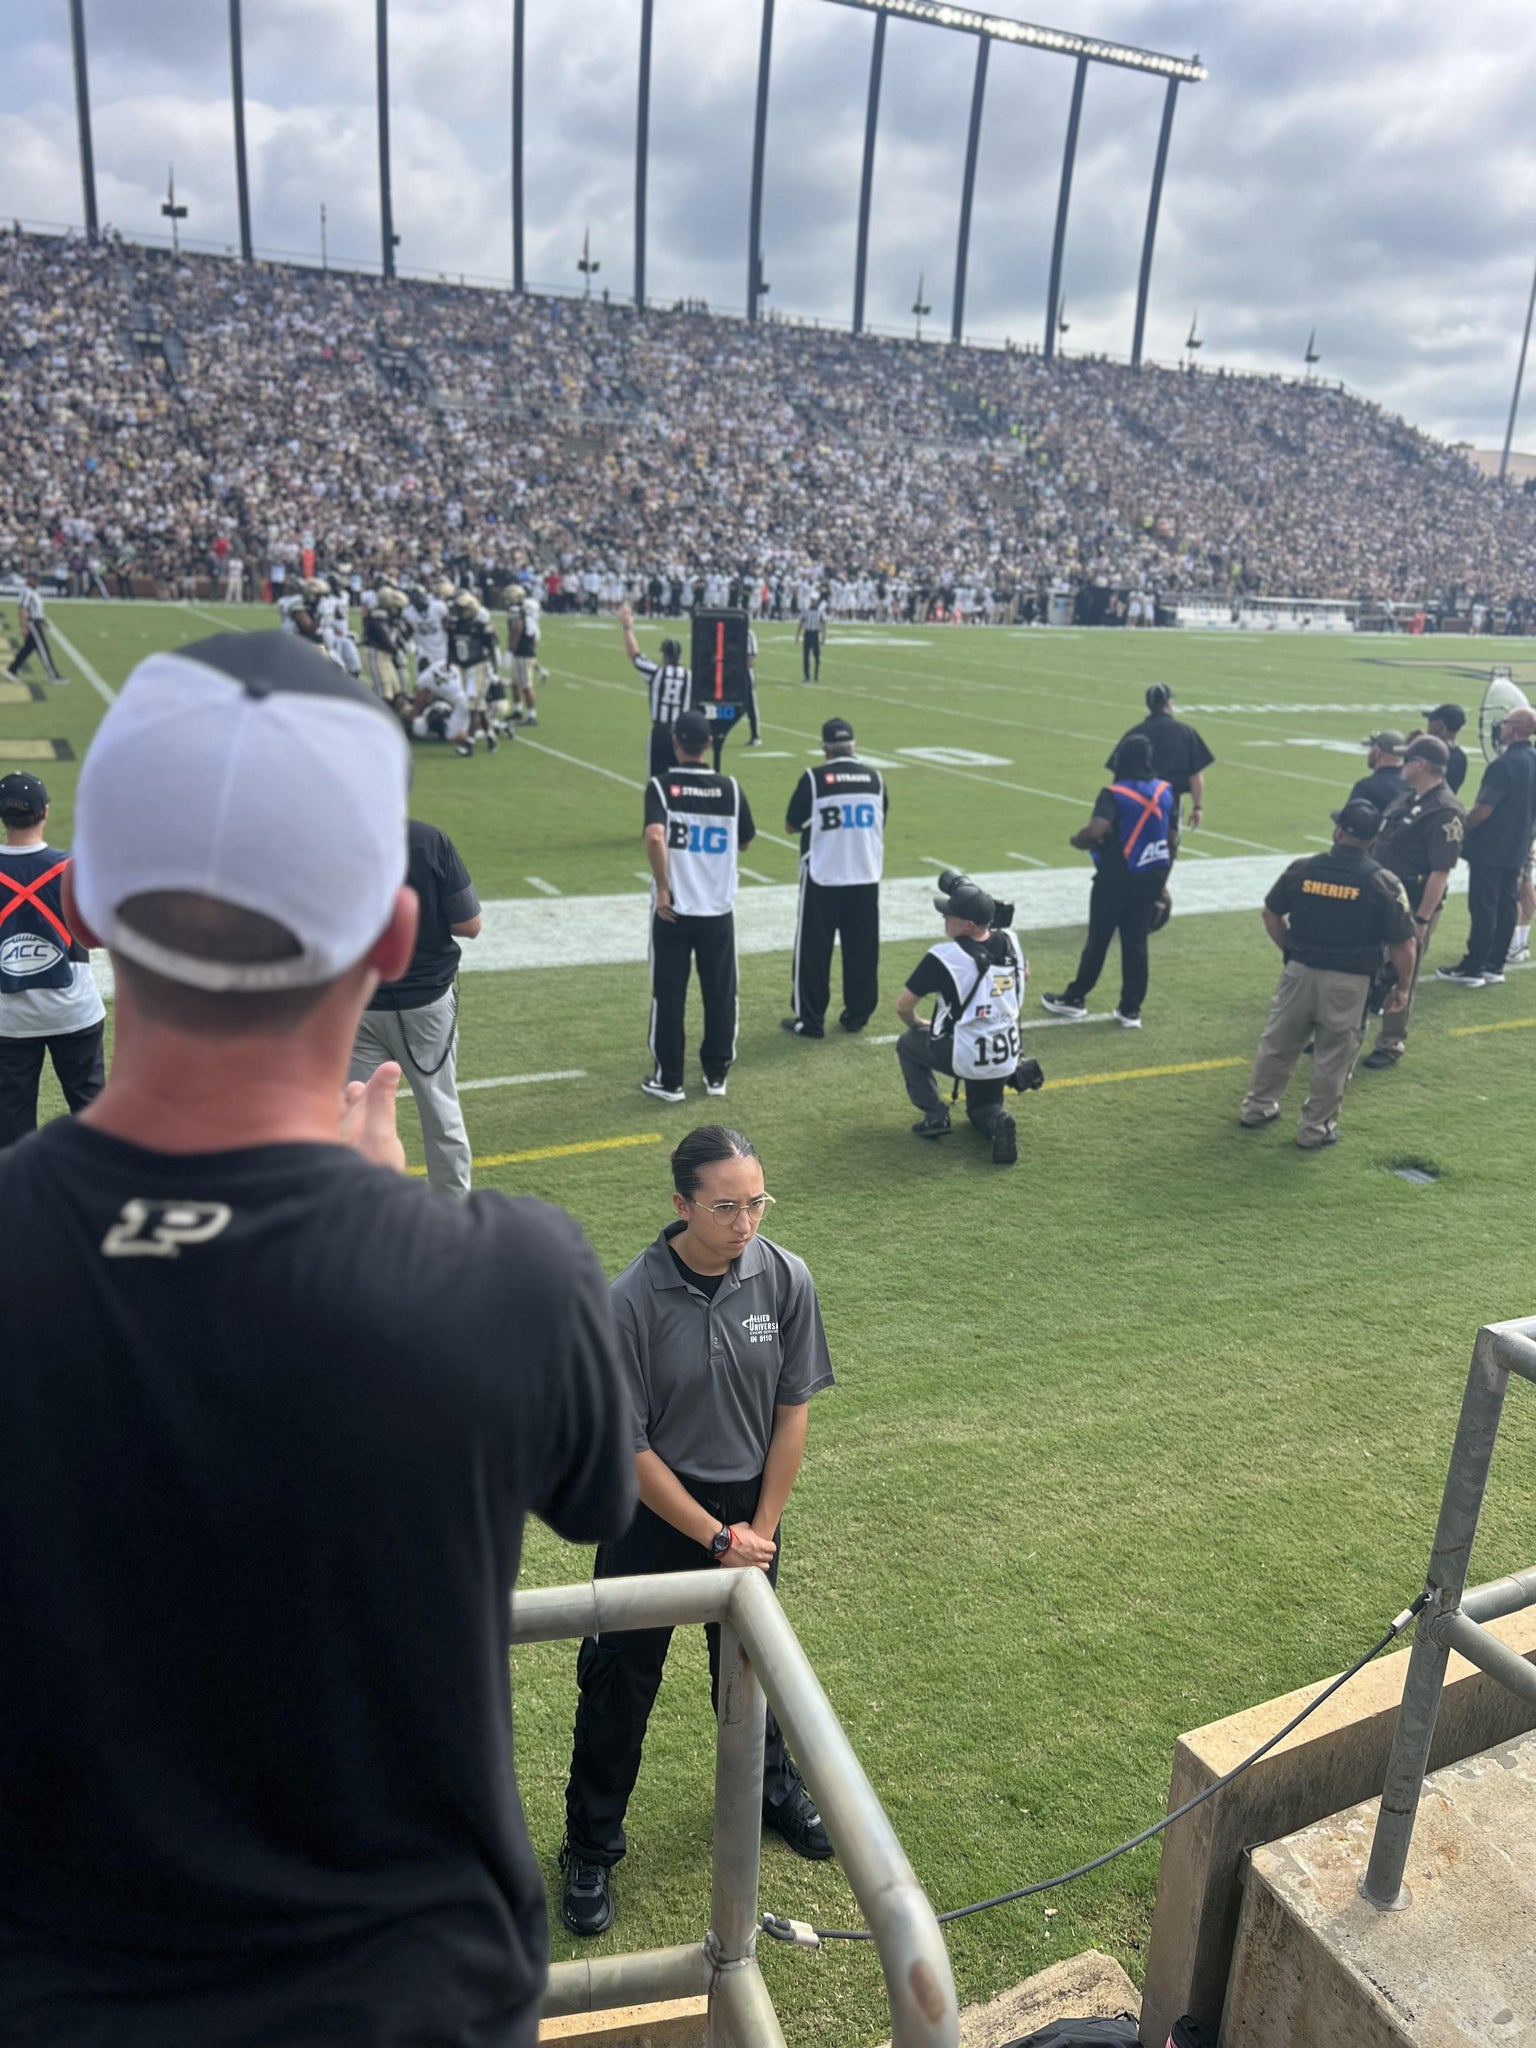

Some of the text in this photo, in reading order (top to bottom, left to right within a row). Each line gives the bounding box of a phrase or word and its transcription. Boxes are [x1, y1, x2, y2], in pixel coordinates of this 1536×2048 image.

[681, 786, 722, 798] STRAUSS
[1302, 880, 1360, 901] SHERIFF
[4, 945, 49, 960] ACC
[750, 1314, 770, 1323] ALLIED
